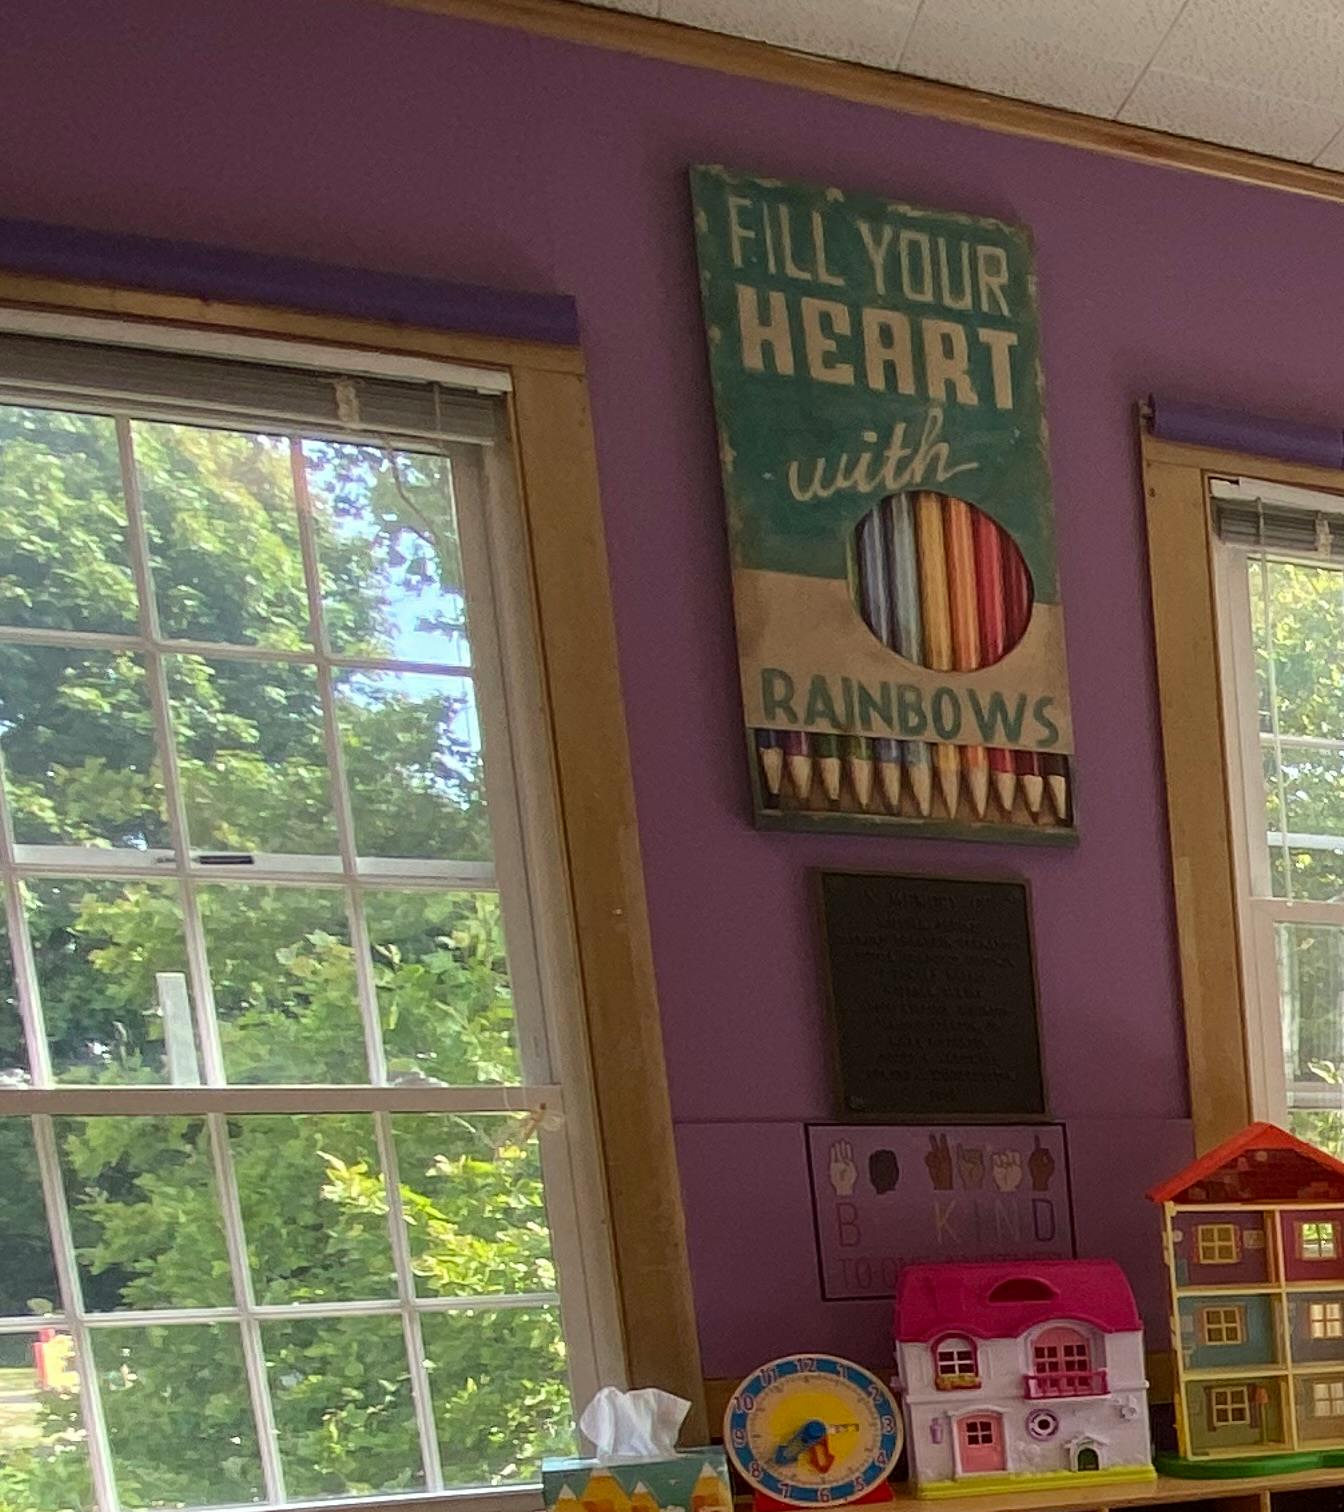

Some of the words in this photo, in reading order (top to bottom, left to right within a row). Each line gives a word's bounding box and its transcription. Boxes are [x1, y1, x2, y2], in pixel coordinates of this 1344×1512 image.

[728, 195, 845, 287] FILL
[856, 219, 1010, 318] YOUR
[736, 283, 1018, 410] HEART
[787, 408, 978, 502] with
[760, 667, 1060, 746] RAINBOWS
[932, 1197, 1057, 1245] KIND
[797, 1357, 817, 1372] 12
[867, 1386, 881, 1403] 2
[735, 1395, 755, 1412] 10
[882, 1417, 895, 1434] 3
[751, 1463, 762, 1478] 8
[818, 1488, 831, 1503] 6
